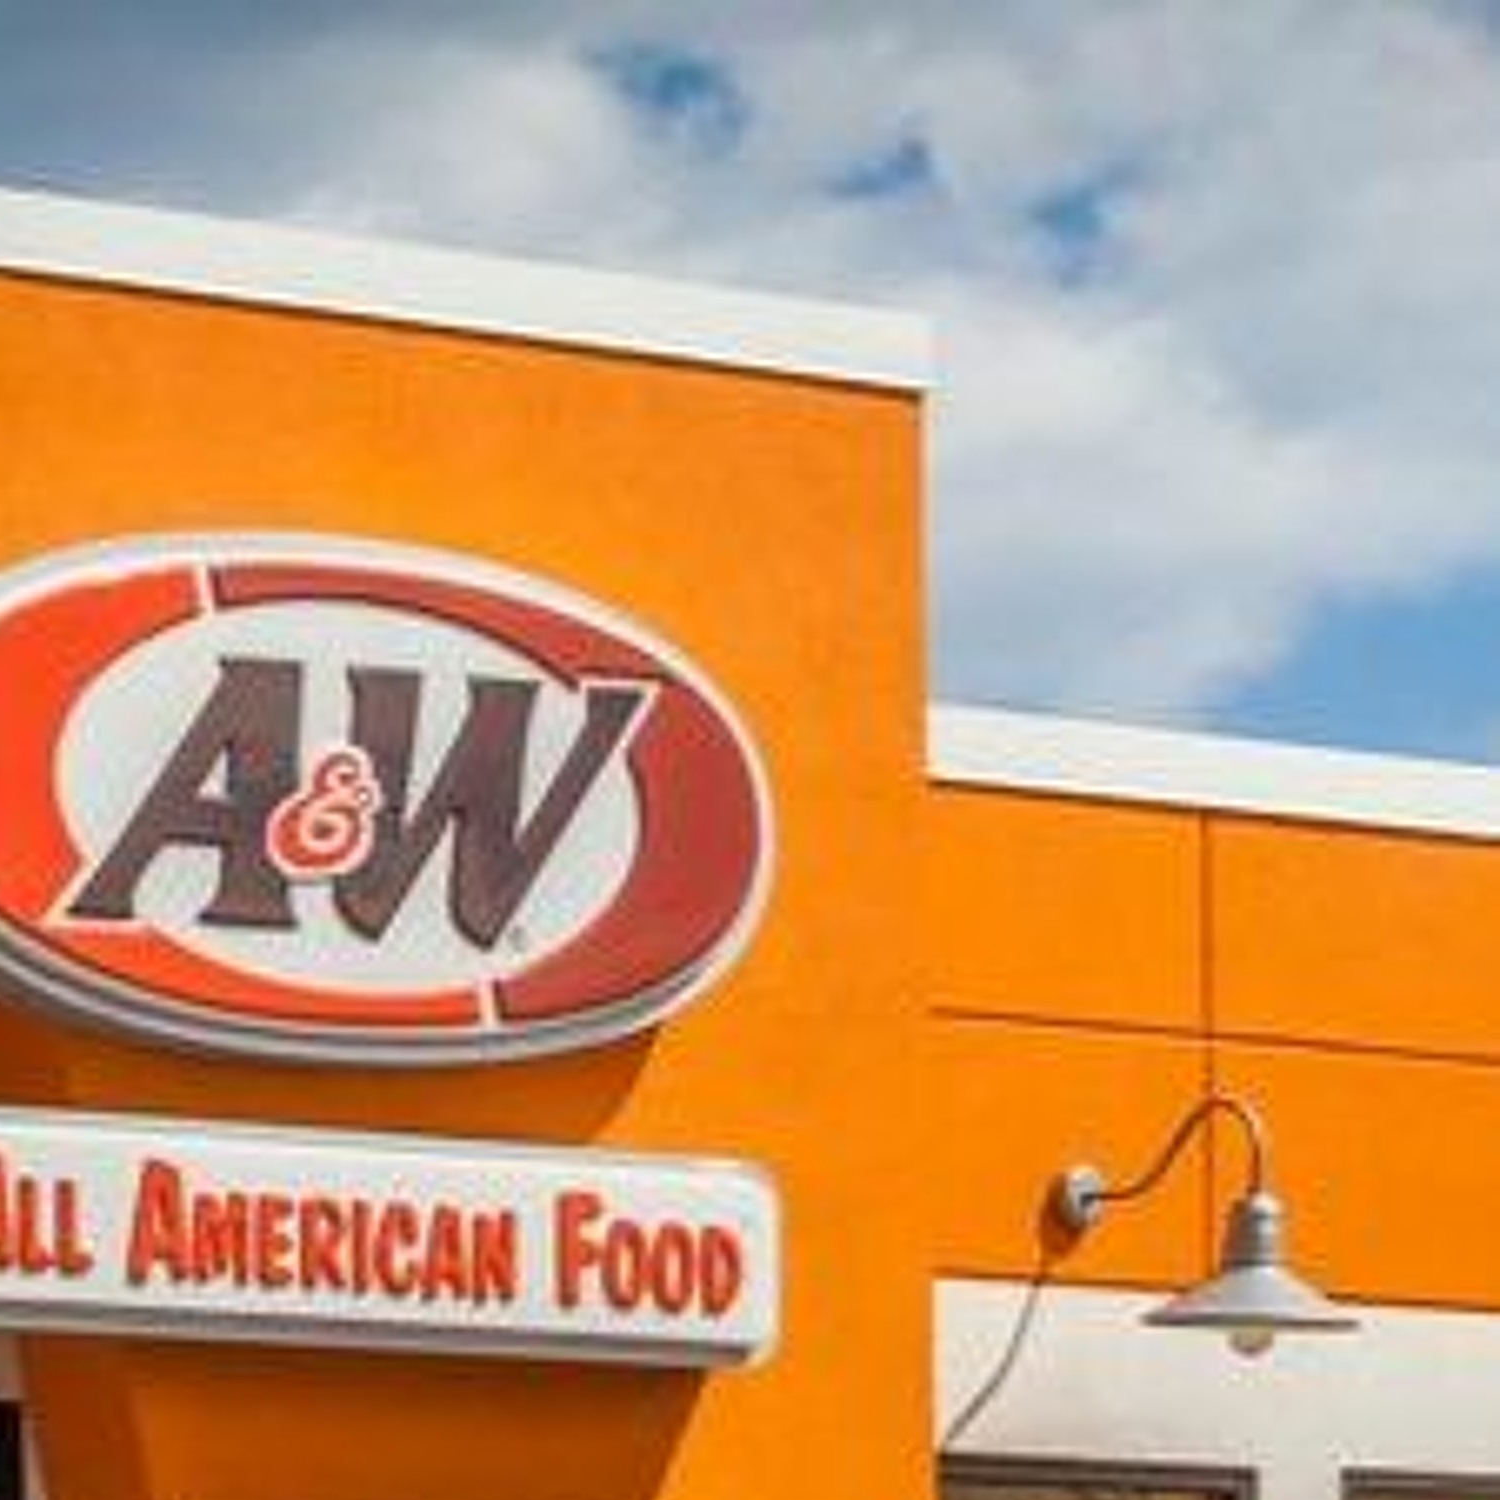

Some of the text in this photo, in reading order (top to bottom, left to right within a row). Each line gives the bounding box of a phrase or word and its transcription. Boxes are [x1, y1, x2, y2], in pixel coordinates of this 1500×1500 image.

[64, 655, 648, 952] A&W
[125, 1155, 516, 1307] AMERICAN
[554, 1190, 743, 1319] FOOD
